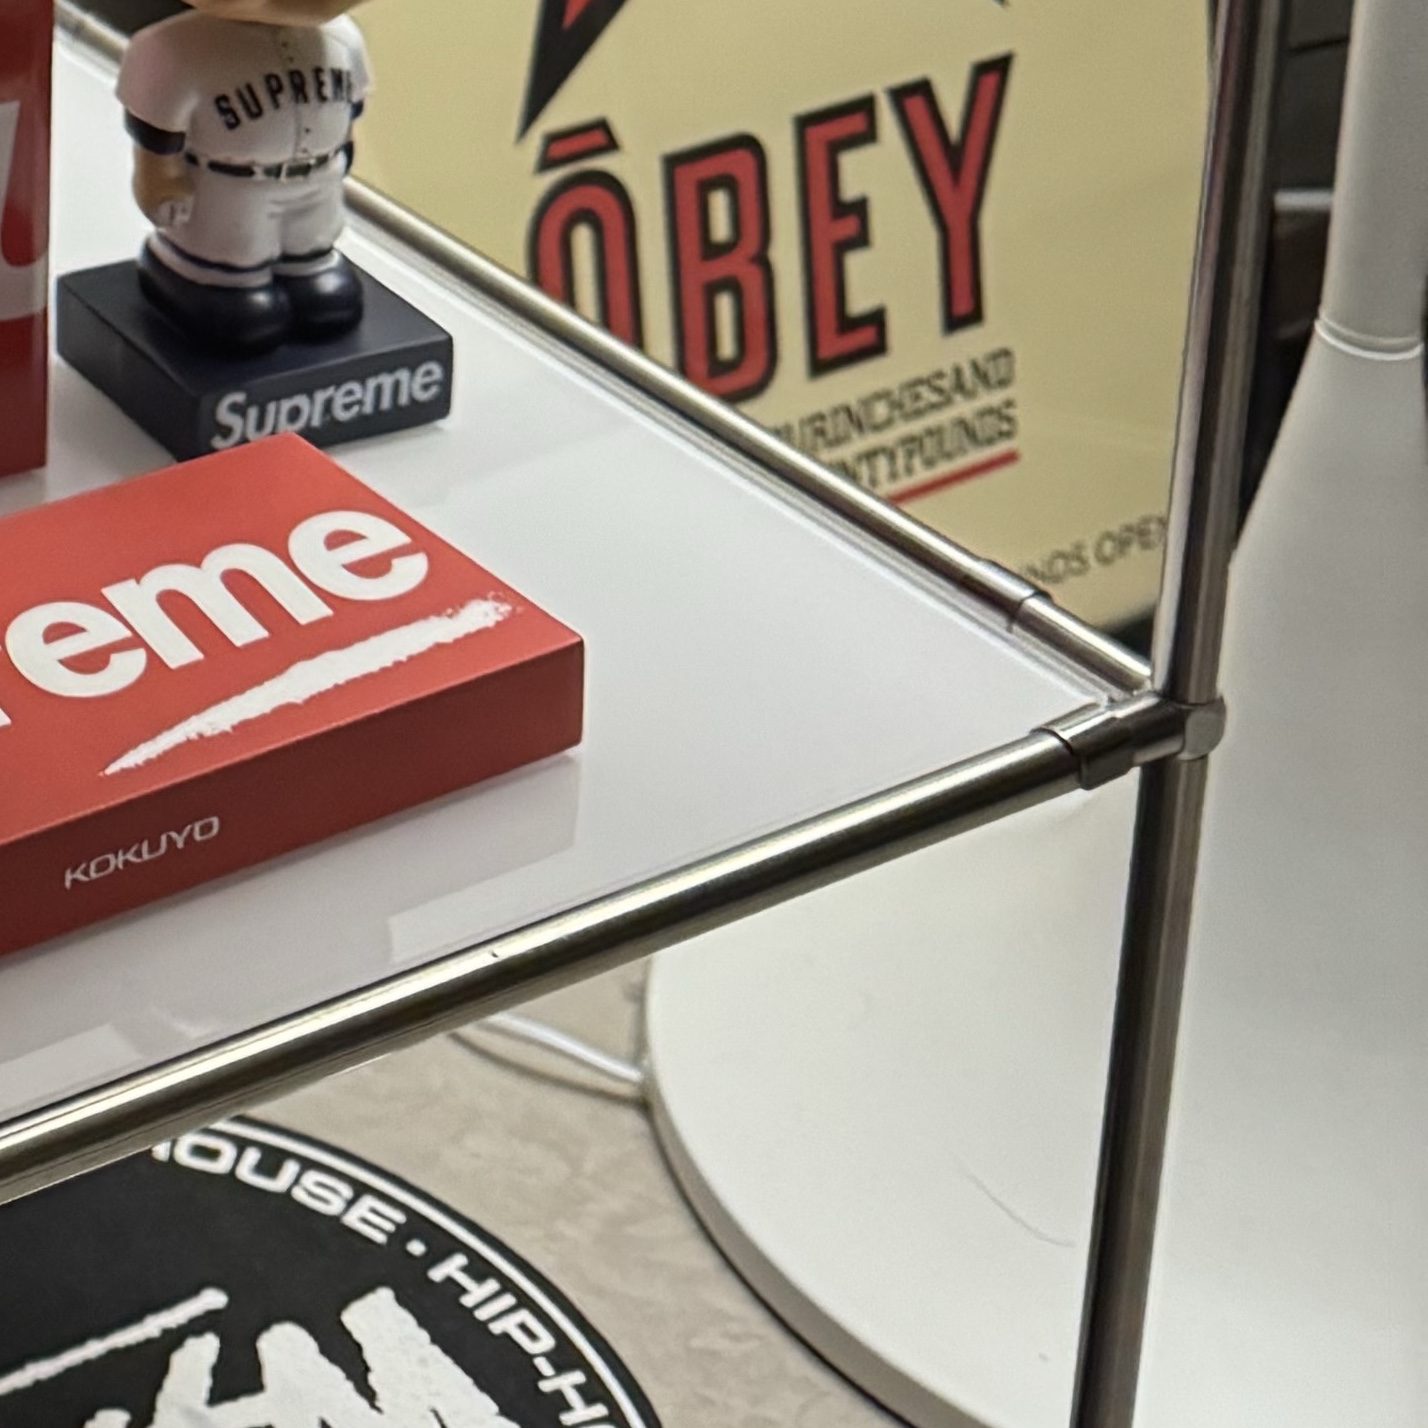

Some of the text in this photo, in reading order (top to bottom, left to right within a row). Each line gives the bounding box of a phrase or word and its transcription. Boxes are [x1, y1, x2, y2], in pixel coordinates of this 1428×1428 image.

[211, 359, 443, 450] Supreme
[63, 815, 221, 890] KOKUYO
[149, 1131, 407, 1245] OUSE
